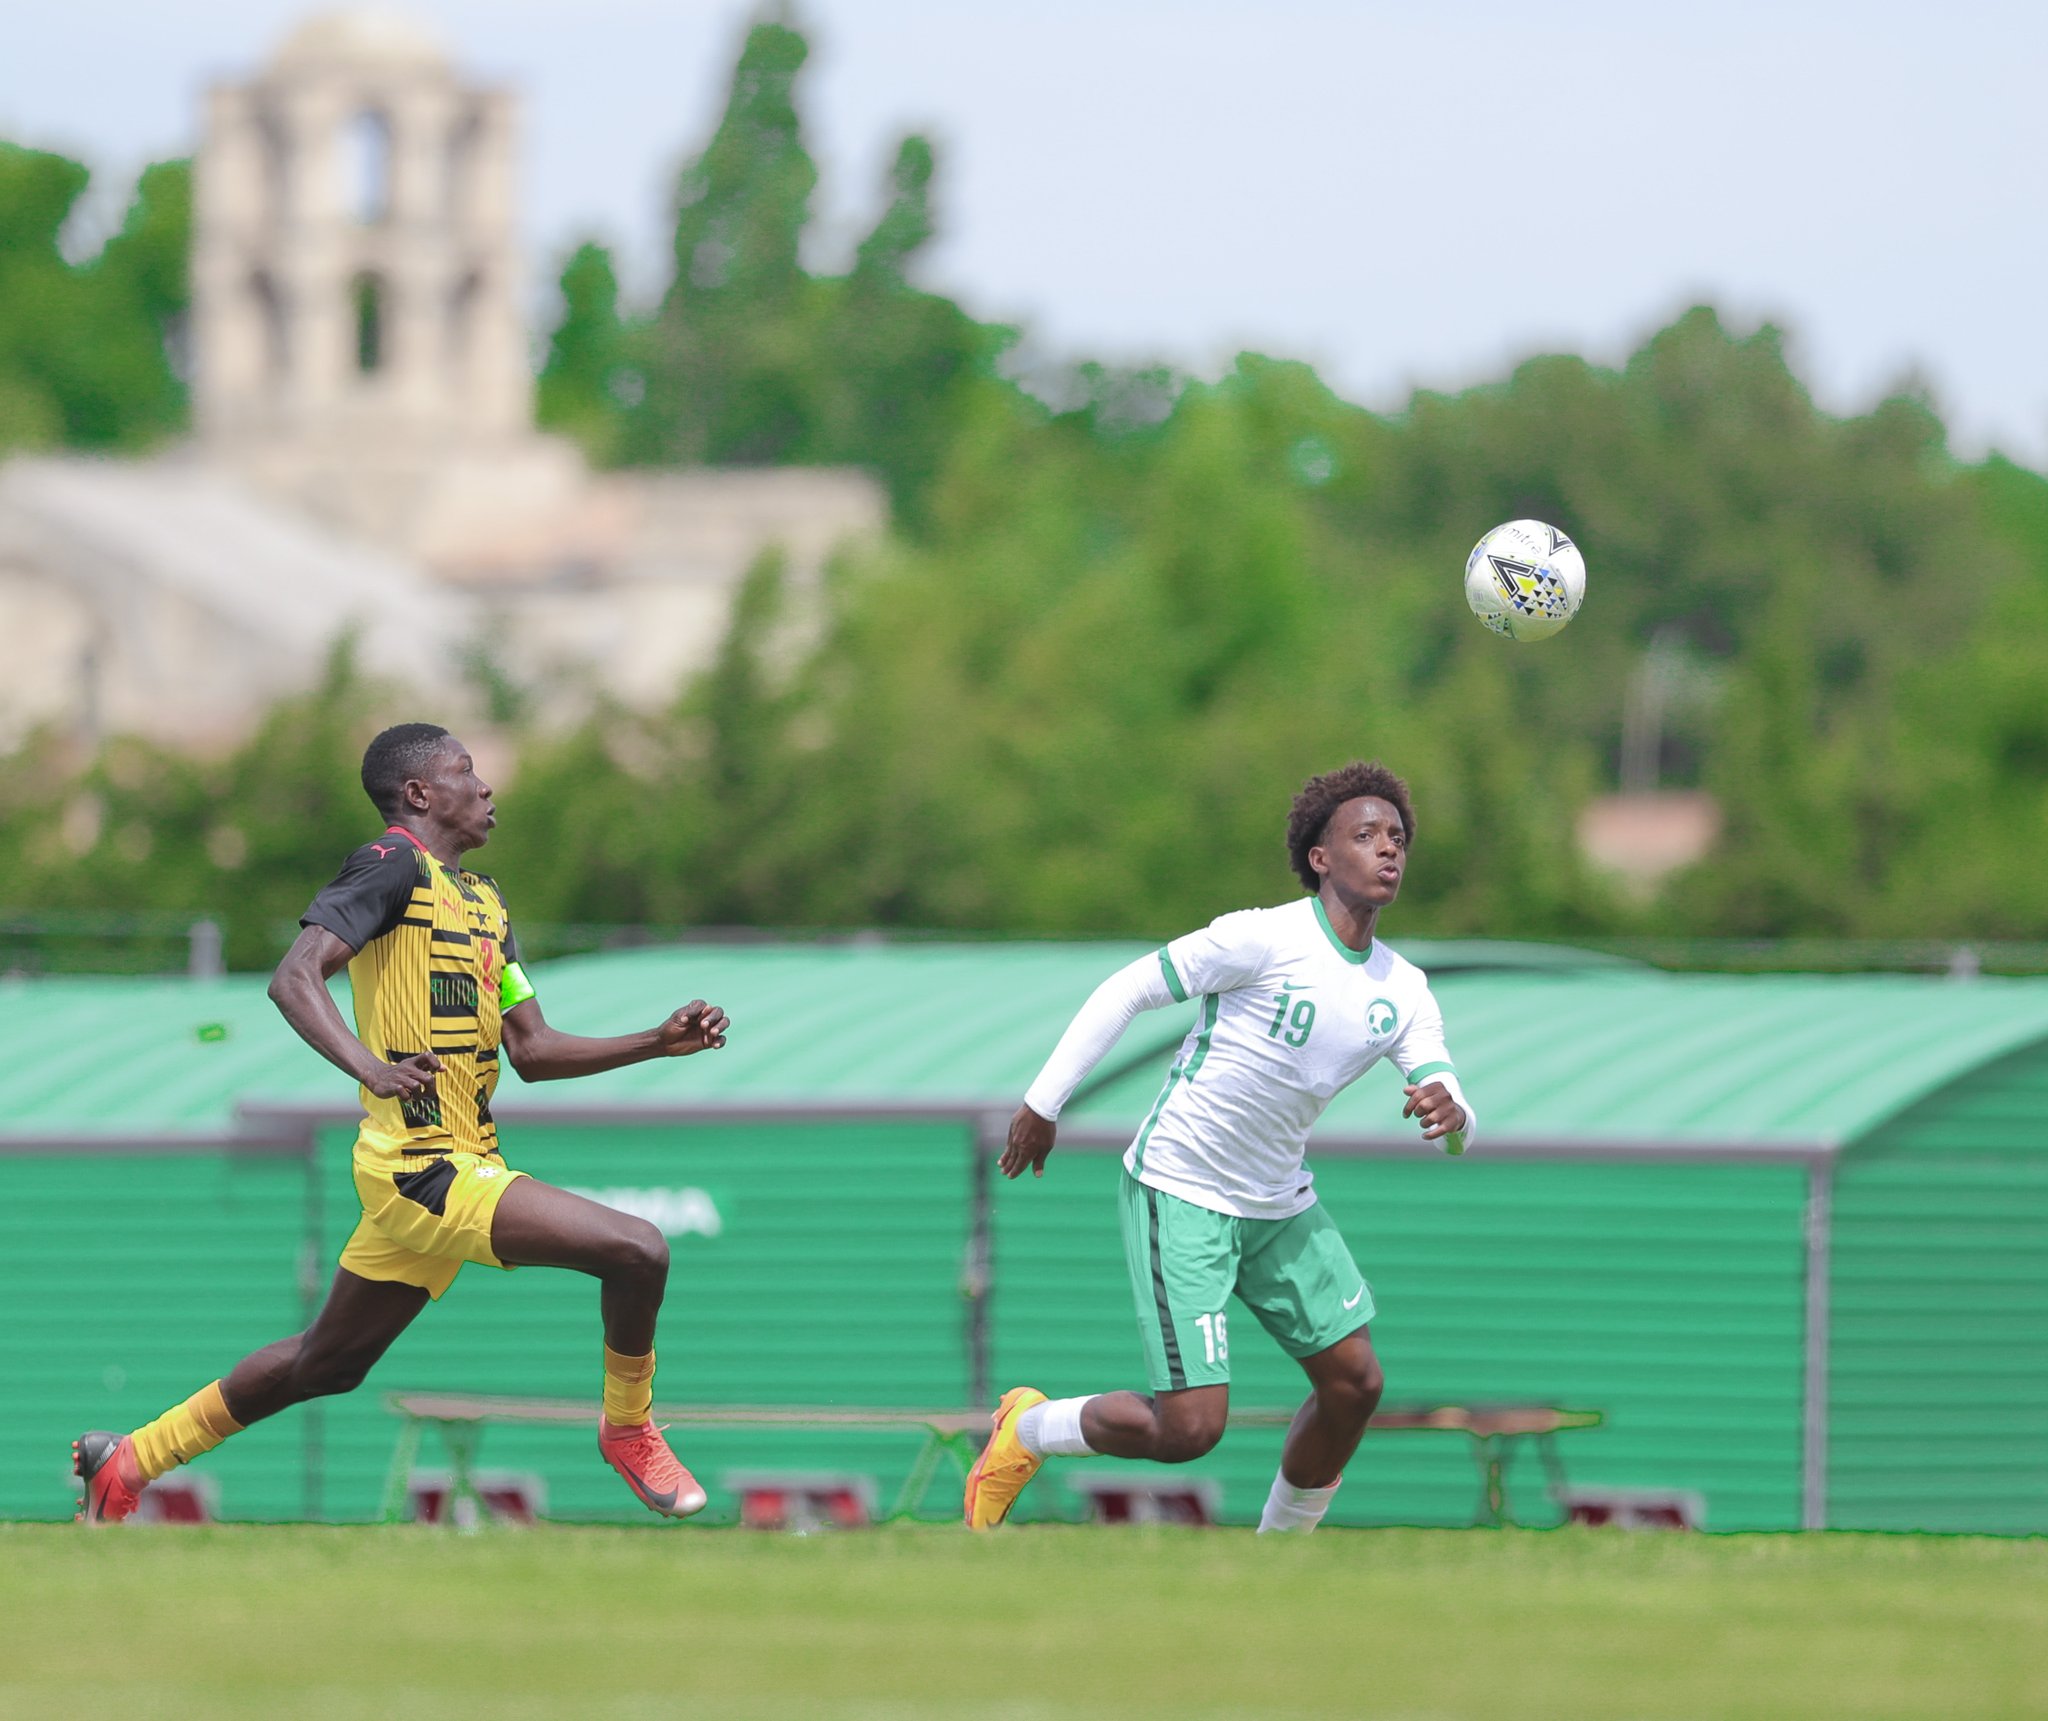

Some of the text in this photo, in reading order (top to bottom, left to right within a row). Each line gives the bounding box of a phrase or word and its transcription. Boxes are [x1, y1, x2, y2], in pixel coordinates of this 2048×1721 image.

[1503, 527, 1542, 555] mitre
[1268, 993, 1316, 1048] 19
[1194, 1311, 1228, 1363] 19
